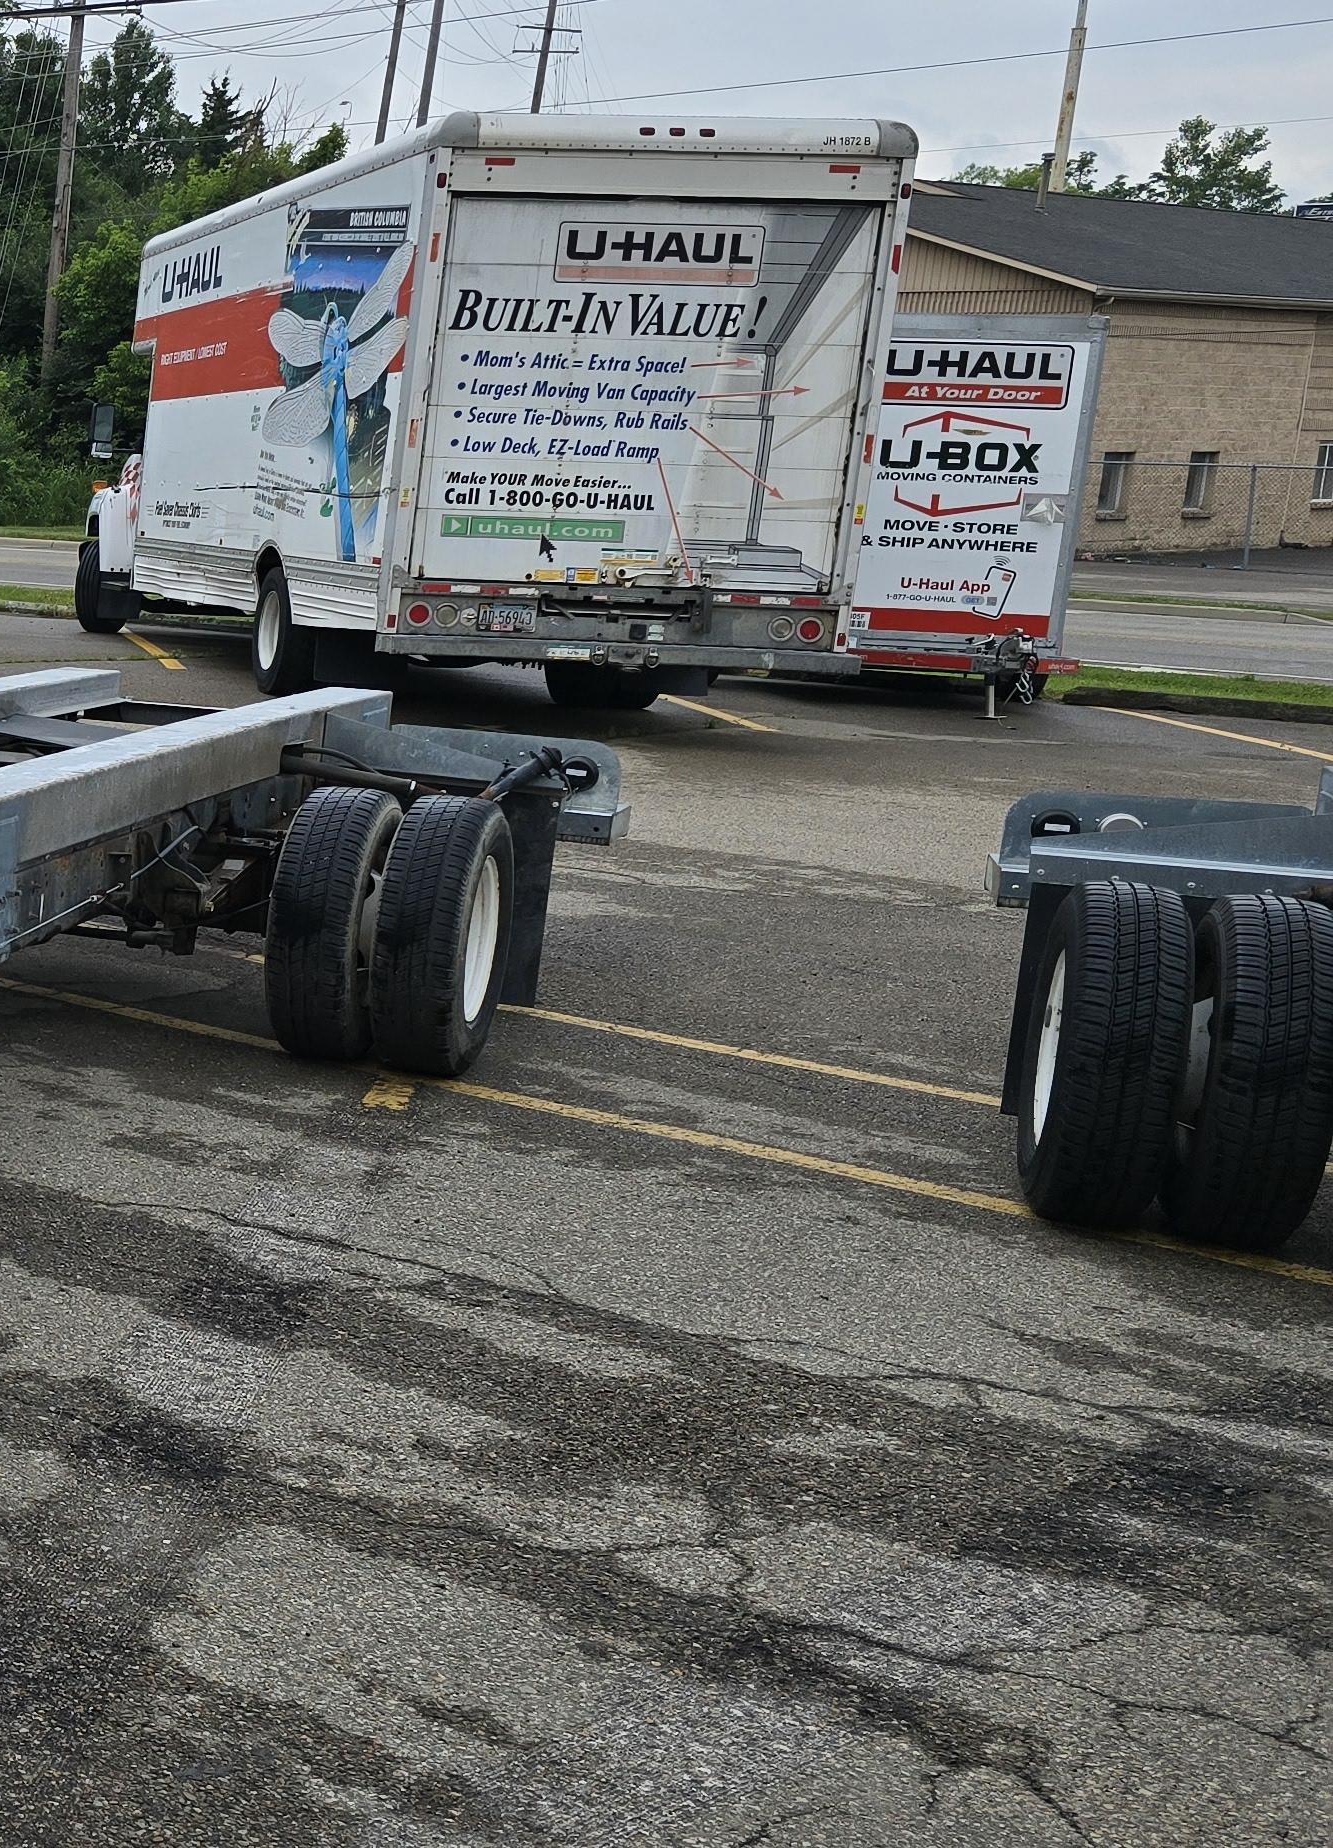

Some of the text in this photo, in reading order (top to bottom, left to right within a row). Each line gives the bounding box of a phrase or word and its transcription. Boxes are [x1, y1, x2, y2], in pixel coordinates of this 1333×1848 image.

[823, 136, 871, 146] JH 1872 B
[566, 229, 753, 265] U-HAUL
[161, 245, 223, 304] U-HAUL
[448, 289, 623, 335] BUILT-IN
[473, 349, 527, 368] Mom's
[530, 351, 569, 370] Attic
[588, 353, 631, 371] Extra
[635, 355, 688, 378] Space!
[886, 348, 1062, 381] U-HAUL
[470, 378, 697, 407] Largest Moving Van Capacity
[904, 385, 1041, 401] At Your Door
[466, 406, 689, 431] Secure Tie-Downs, Rub Rails
[462, 435, 660, 464] Low Deck, EZ-Load Ramp
[879, 438, 1043, 474] U-BOX
[446, 471, 632, 490] Make YOUR Move Easier...
[876, 471, 1039, 486] MOVING CONTAINERS
[444, 487, 655, 512] Call 1-800-GO-U-HAUL
[478, 521, 613, 538] uhaul.com
[883, 518, 1019, 536] MOVE STORE
[861, 535, 1039, 554] & SHIP ANYWHERE
[886, 593, 957, 603] 1-877-GO-U-HAUL
[900, 576, 991, 595] U-Haul App
